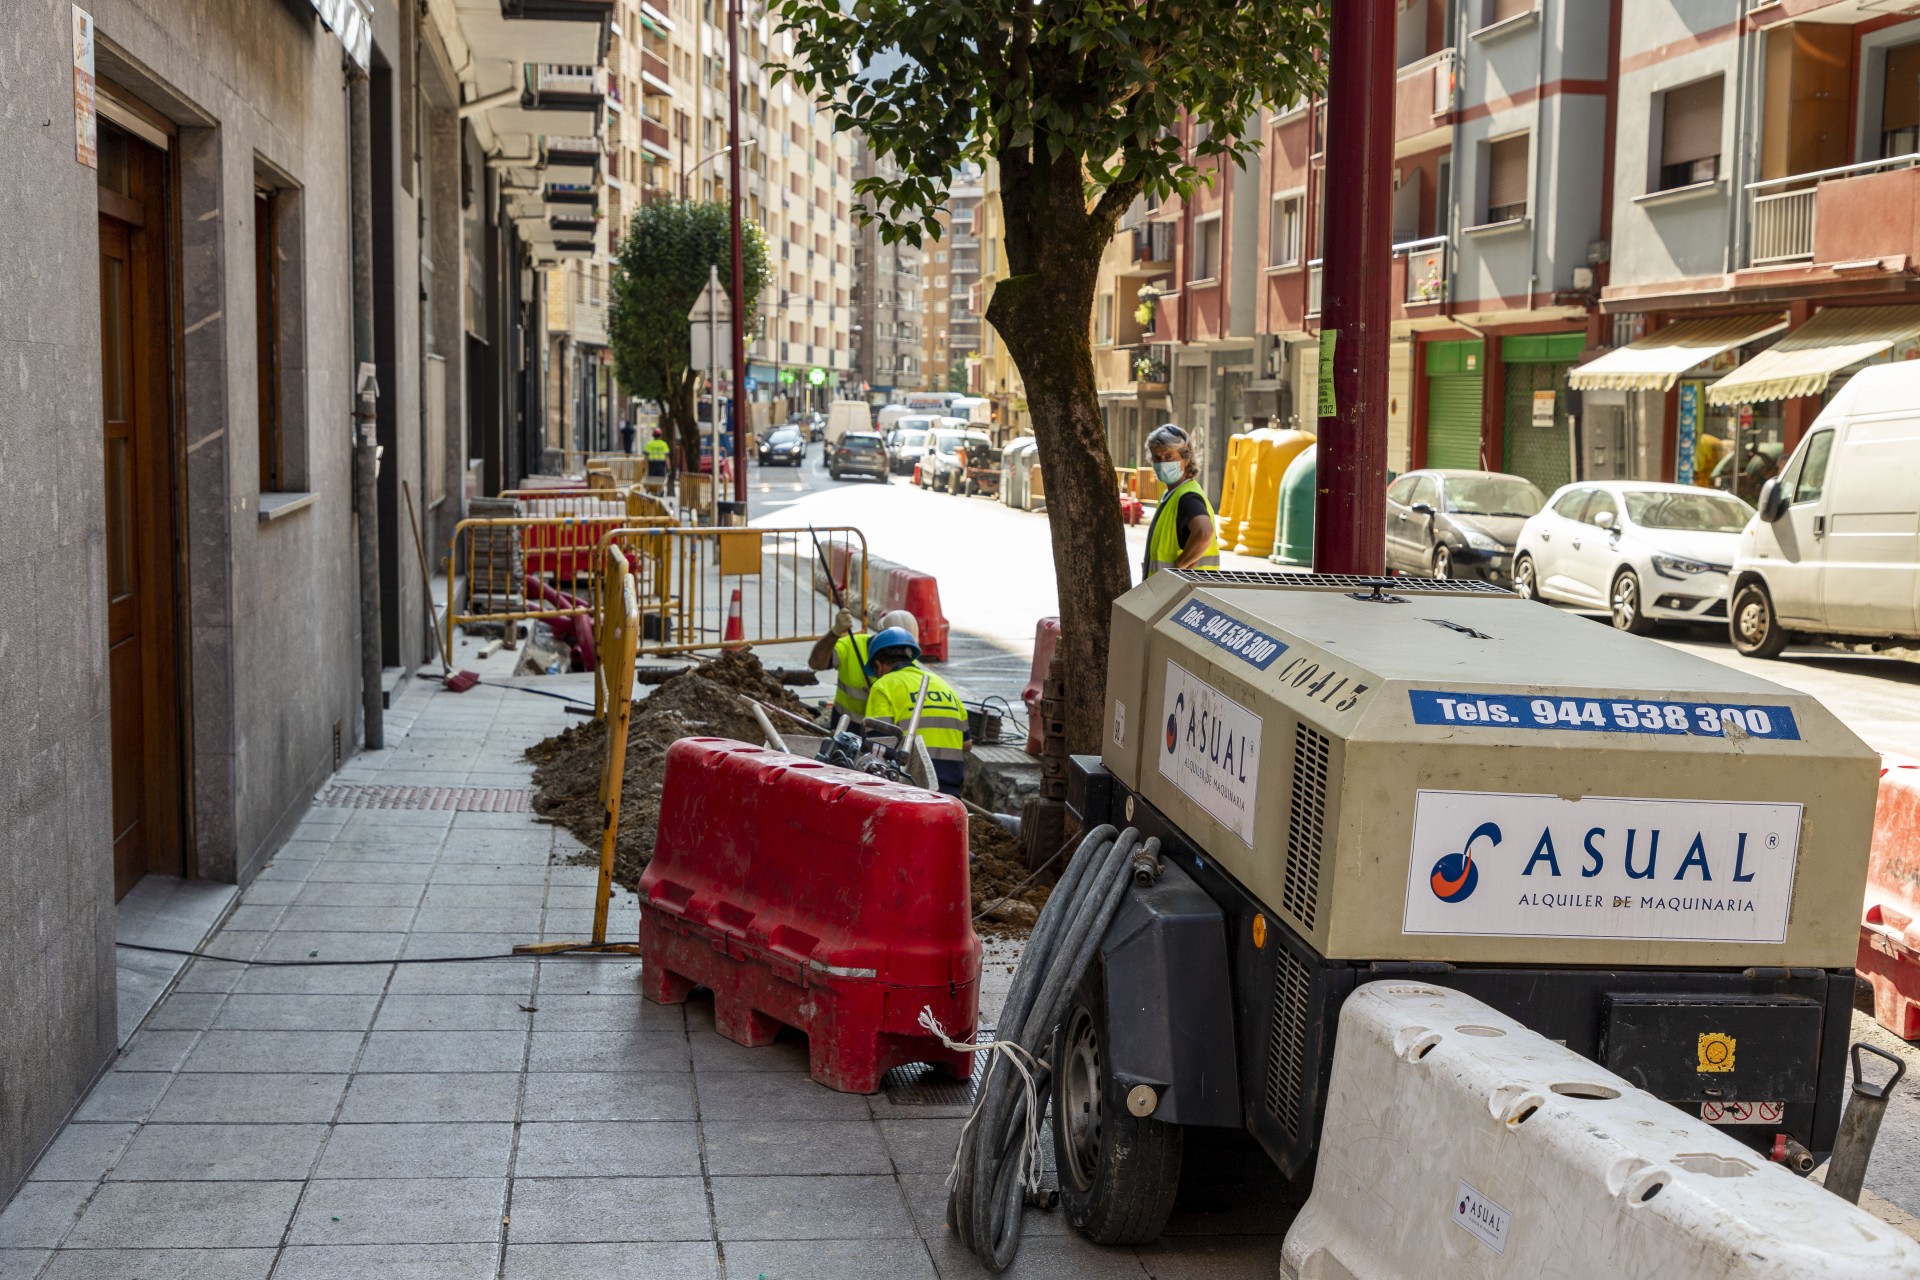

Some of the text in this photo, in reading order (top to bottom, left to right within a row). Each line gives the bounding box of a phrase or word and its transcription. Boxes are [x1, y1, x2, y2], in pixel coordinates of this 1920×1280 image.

[1180, 605, 1277, 662] Tels. 944 538 300
[1436, 698, 1772, 734] Tels. 944 538 300
[1186, 704, 1247, 784] ASUAL
[1184, 757, 1246, 812] ALQUILER DE MAQUINARIA
[1521, 826, 1756, 883] ASUAL
[1518, 893, 1755, 912] ALQUILER DE MAQUINARIA
[1470, 1201, 1501, 1232] ASUAL
